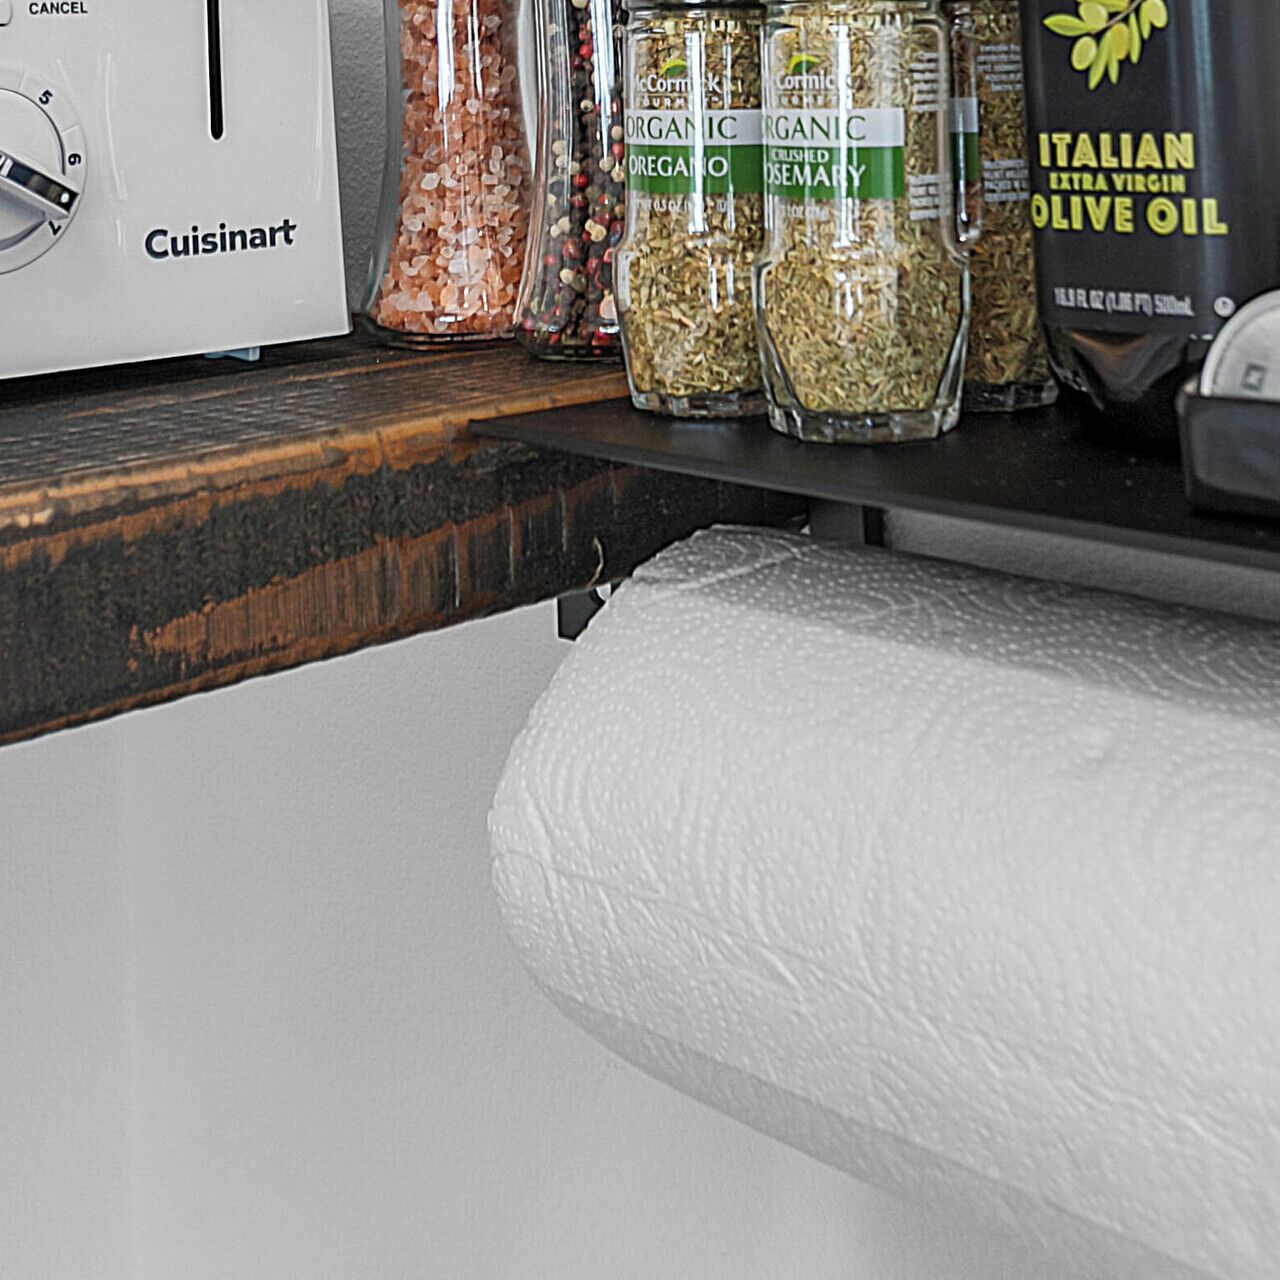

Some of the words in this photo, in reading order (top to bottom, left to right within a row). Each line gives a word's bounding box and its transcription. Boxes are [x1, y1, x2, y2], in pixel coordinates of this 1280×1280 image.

[28, 2, 88, 15] CANCEL
[38, 91, 53, 105] 5
[766, 115, 866, 140] RGANIC
[68, 153, 82, 165] 6
[1038, 132, 1196, 170] ITALIAN
[767, 164, 866, 187] OSEMARY
[1049, 173, 1109, 193] EXTRA
[1112, 173, 1186, 193] VIRGIN
[1031, 193, 1134, 232] OLIVE
[1146, 197, 1229, 236] OIL
[144, 220, 297, 260] Cuisinart
[1089, 290, 1104, 310] OZ
